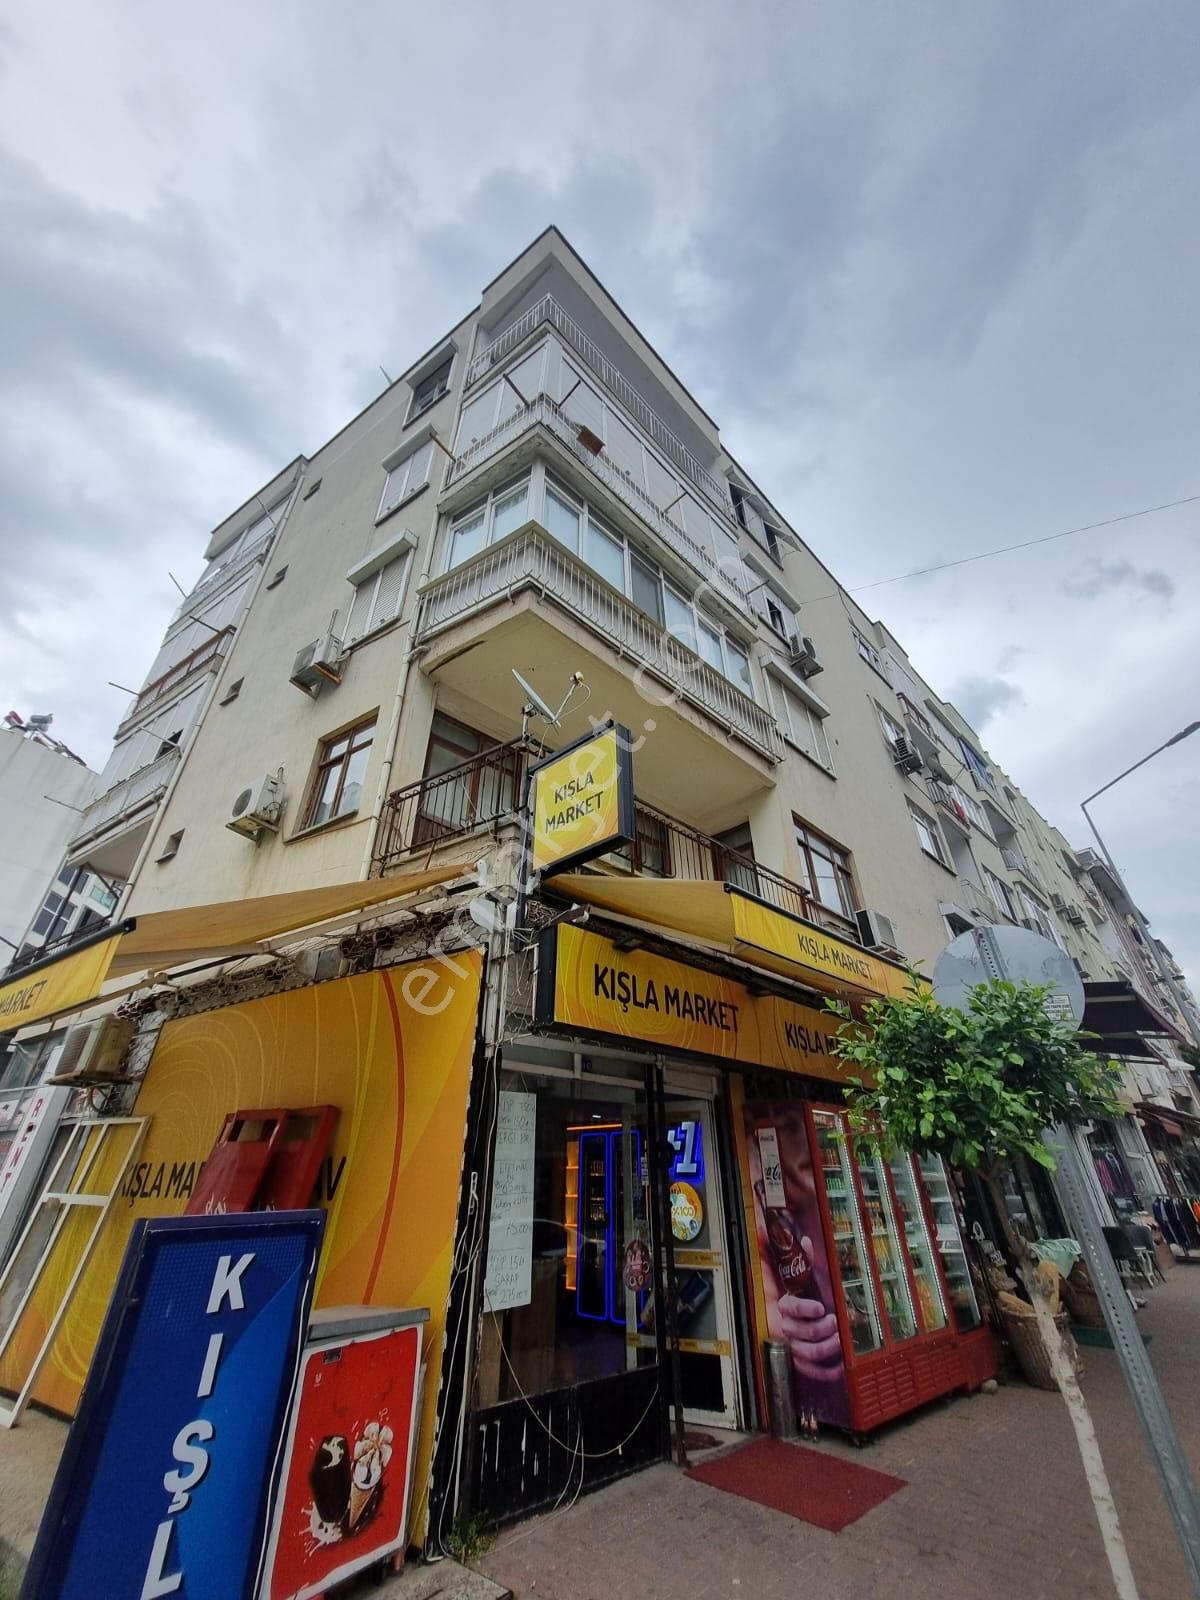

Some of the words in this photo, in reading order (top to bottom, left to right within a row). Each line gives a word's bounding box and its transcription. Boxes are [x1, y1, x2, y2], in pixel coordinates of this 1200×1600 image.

[554, 771, 594, 804] KIŞLA
[545, 790, 604, 834] MARKET
[797, 932, 832, 964] KIŞLA
[831, 947, 873, 981] MARKET
[594, 963, 660, 1014] KIŞLA
[664, 984, 739, 1034] MARKET
[784, 1021, 825, 1058] KIŞLA
